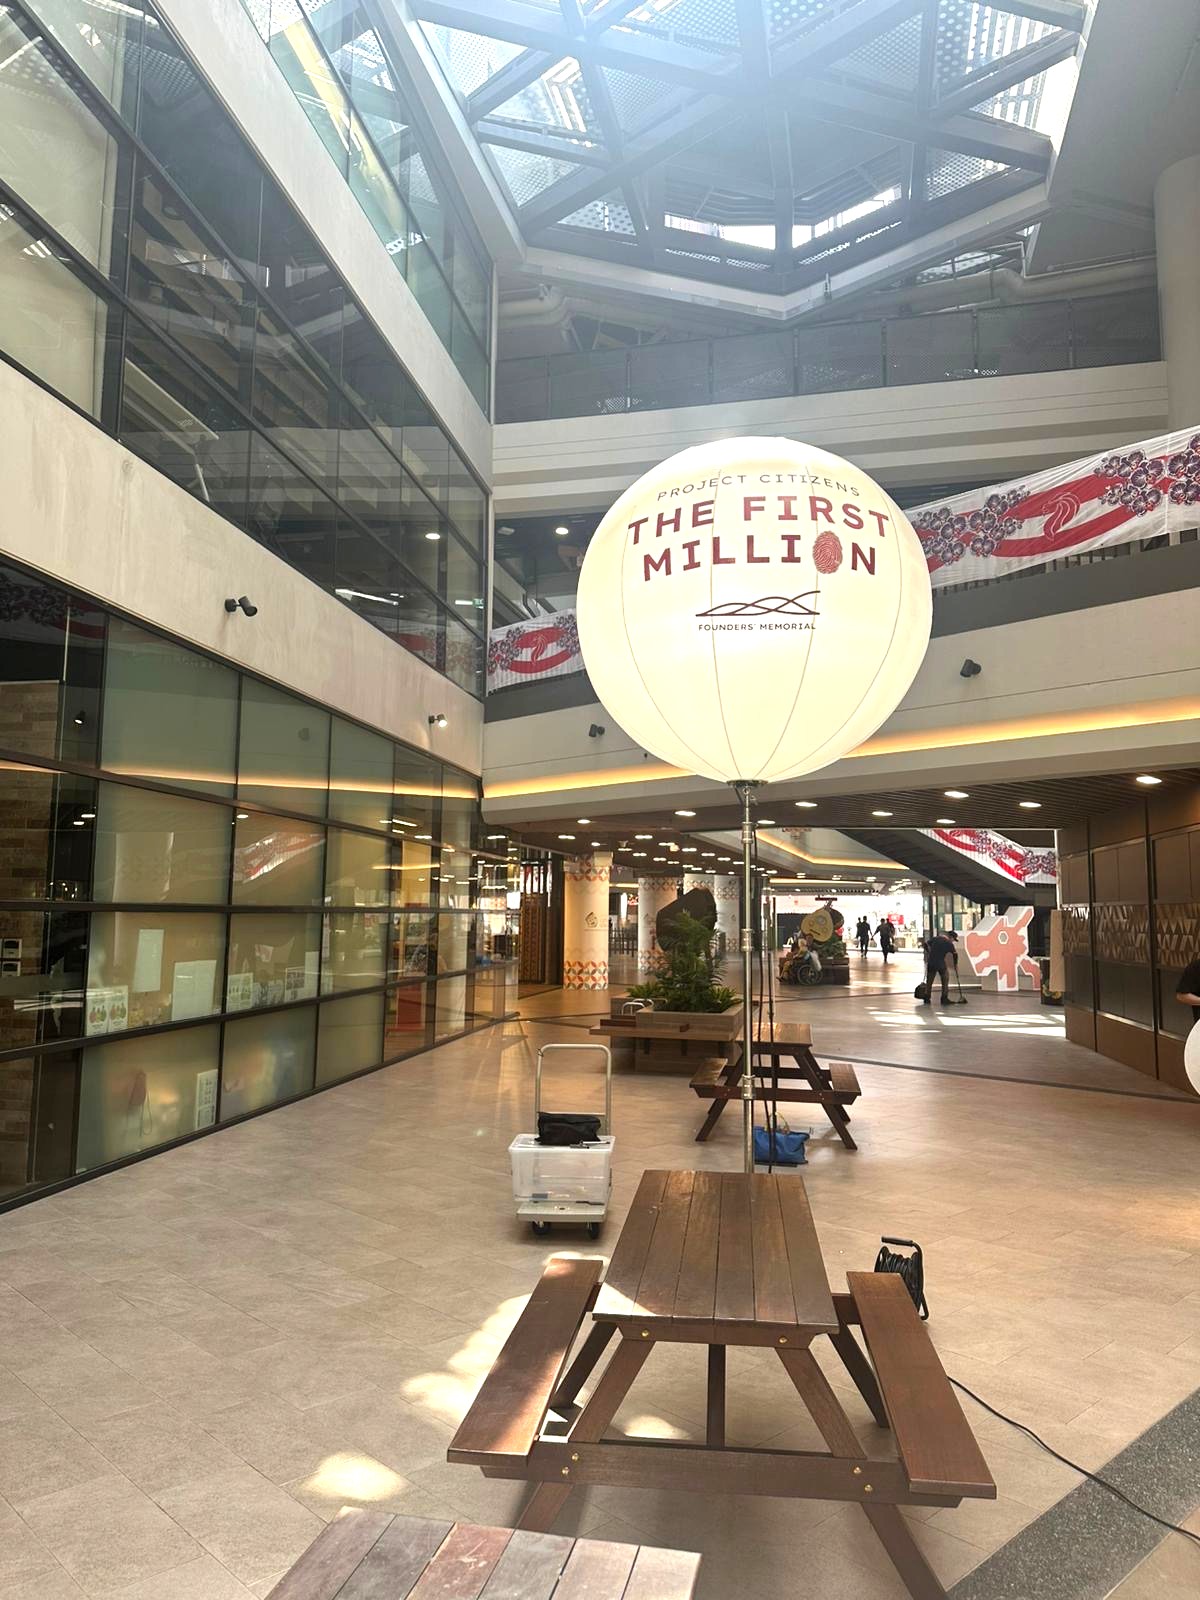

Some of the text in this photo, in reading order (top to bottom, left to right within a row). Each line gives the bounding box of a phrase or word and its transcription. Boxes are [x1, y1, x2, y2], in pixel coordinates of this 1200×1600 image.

[657, 474, 860, 501] PROJECT CITIZENS
[628, 495, 889, 545] THE FIRST
[643, 530, 876, 582] MILLION
[759, 622, 817, 630] MEMORIAL
